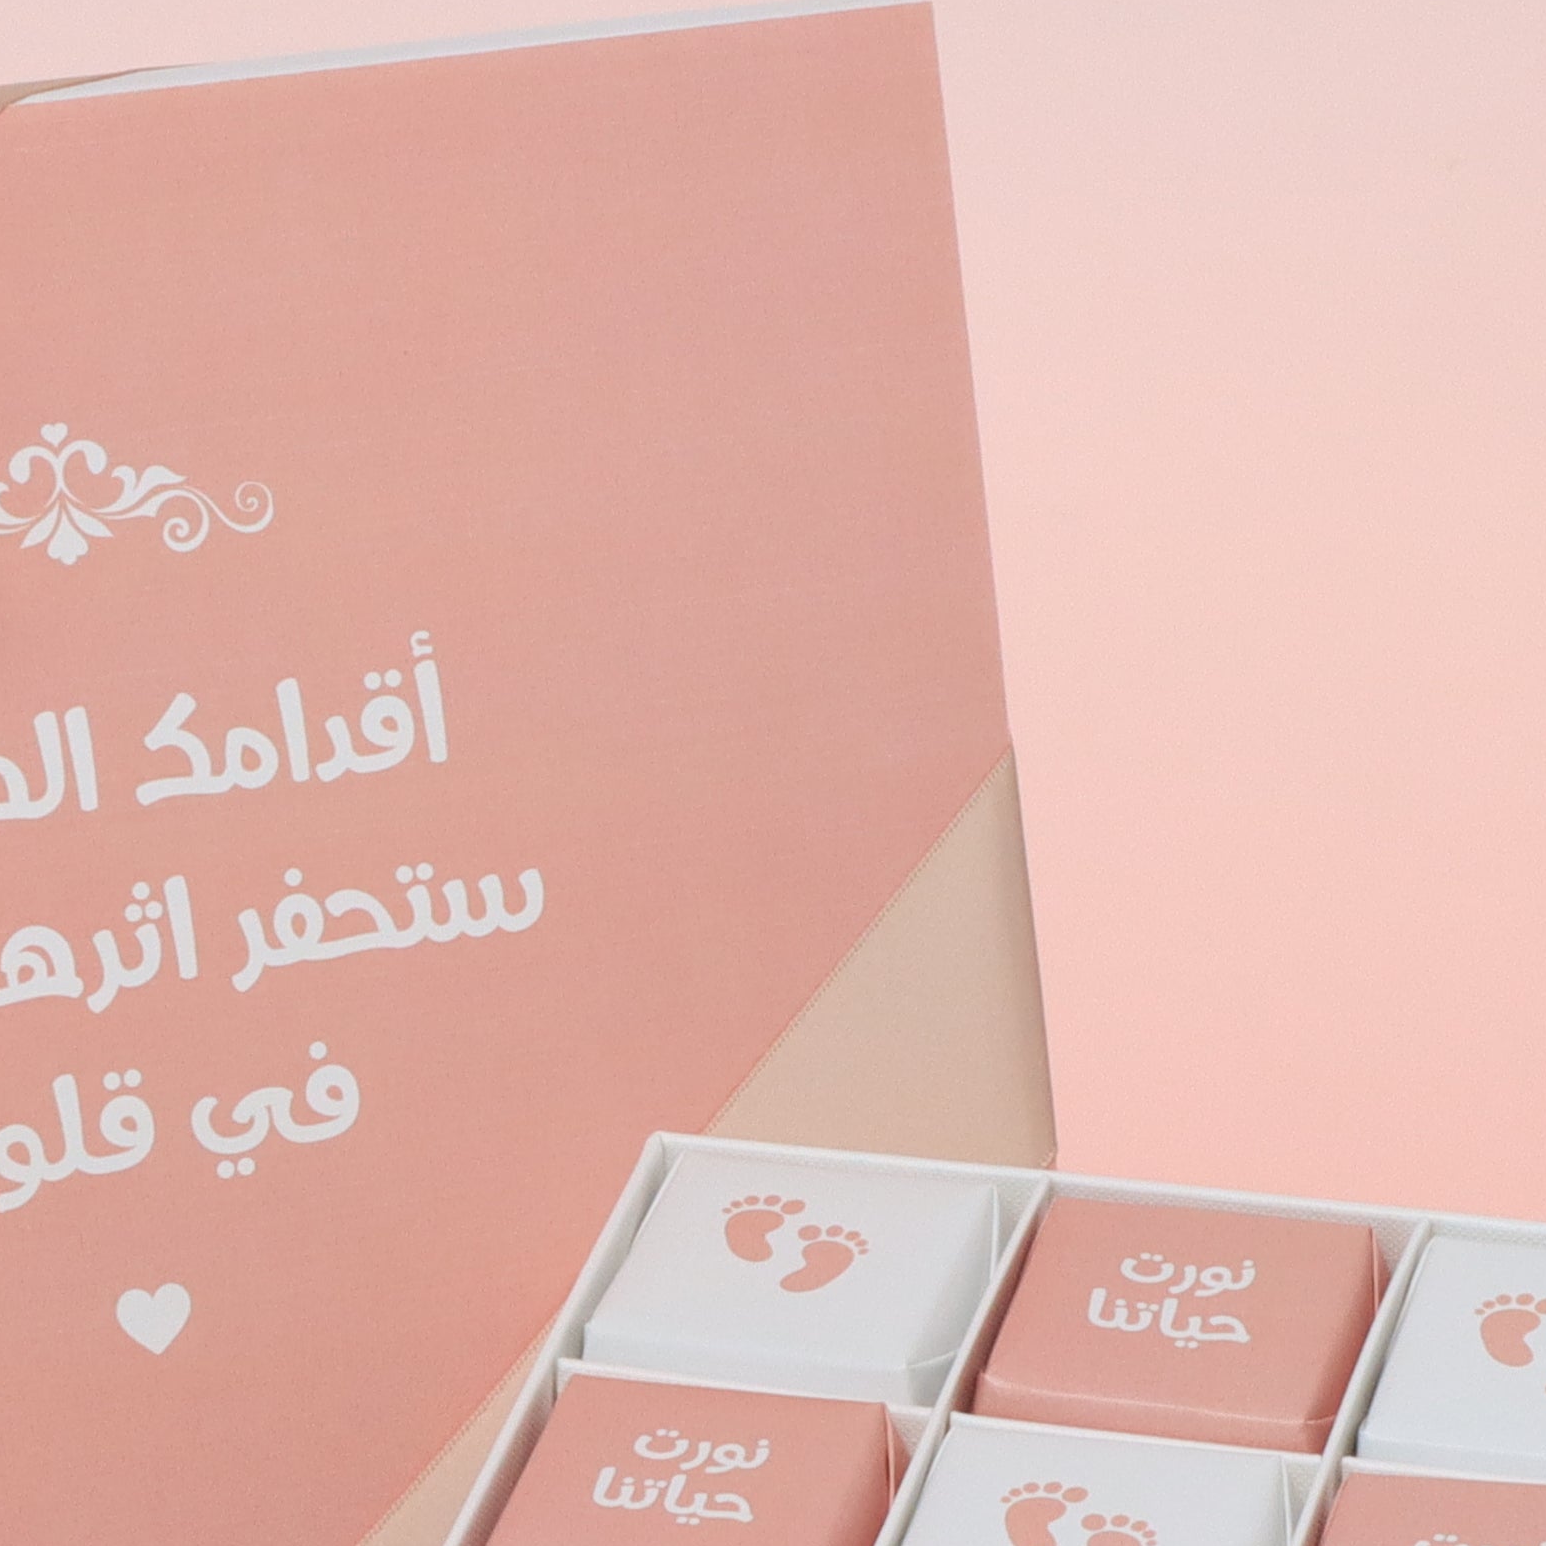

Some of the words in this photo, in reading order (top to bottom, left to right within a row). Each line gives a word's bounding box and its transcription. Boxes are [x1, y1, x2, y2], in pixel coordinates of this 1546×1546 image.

[232, 863, 545, 992] ستحفر
[190, 1041, 361, 1179] في
[1120, 1252, 1257, 1298] نورت
[1088, 1287, 1251, 1349] حياتنا
[633, 1428, 770, 1474] نورت
[592, 1466, 754, 1526] حياتنا
